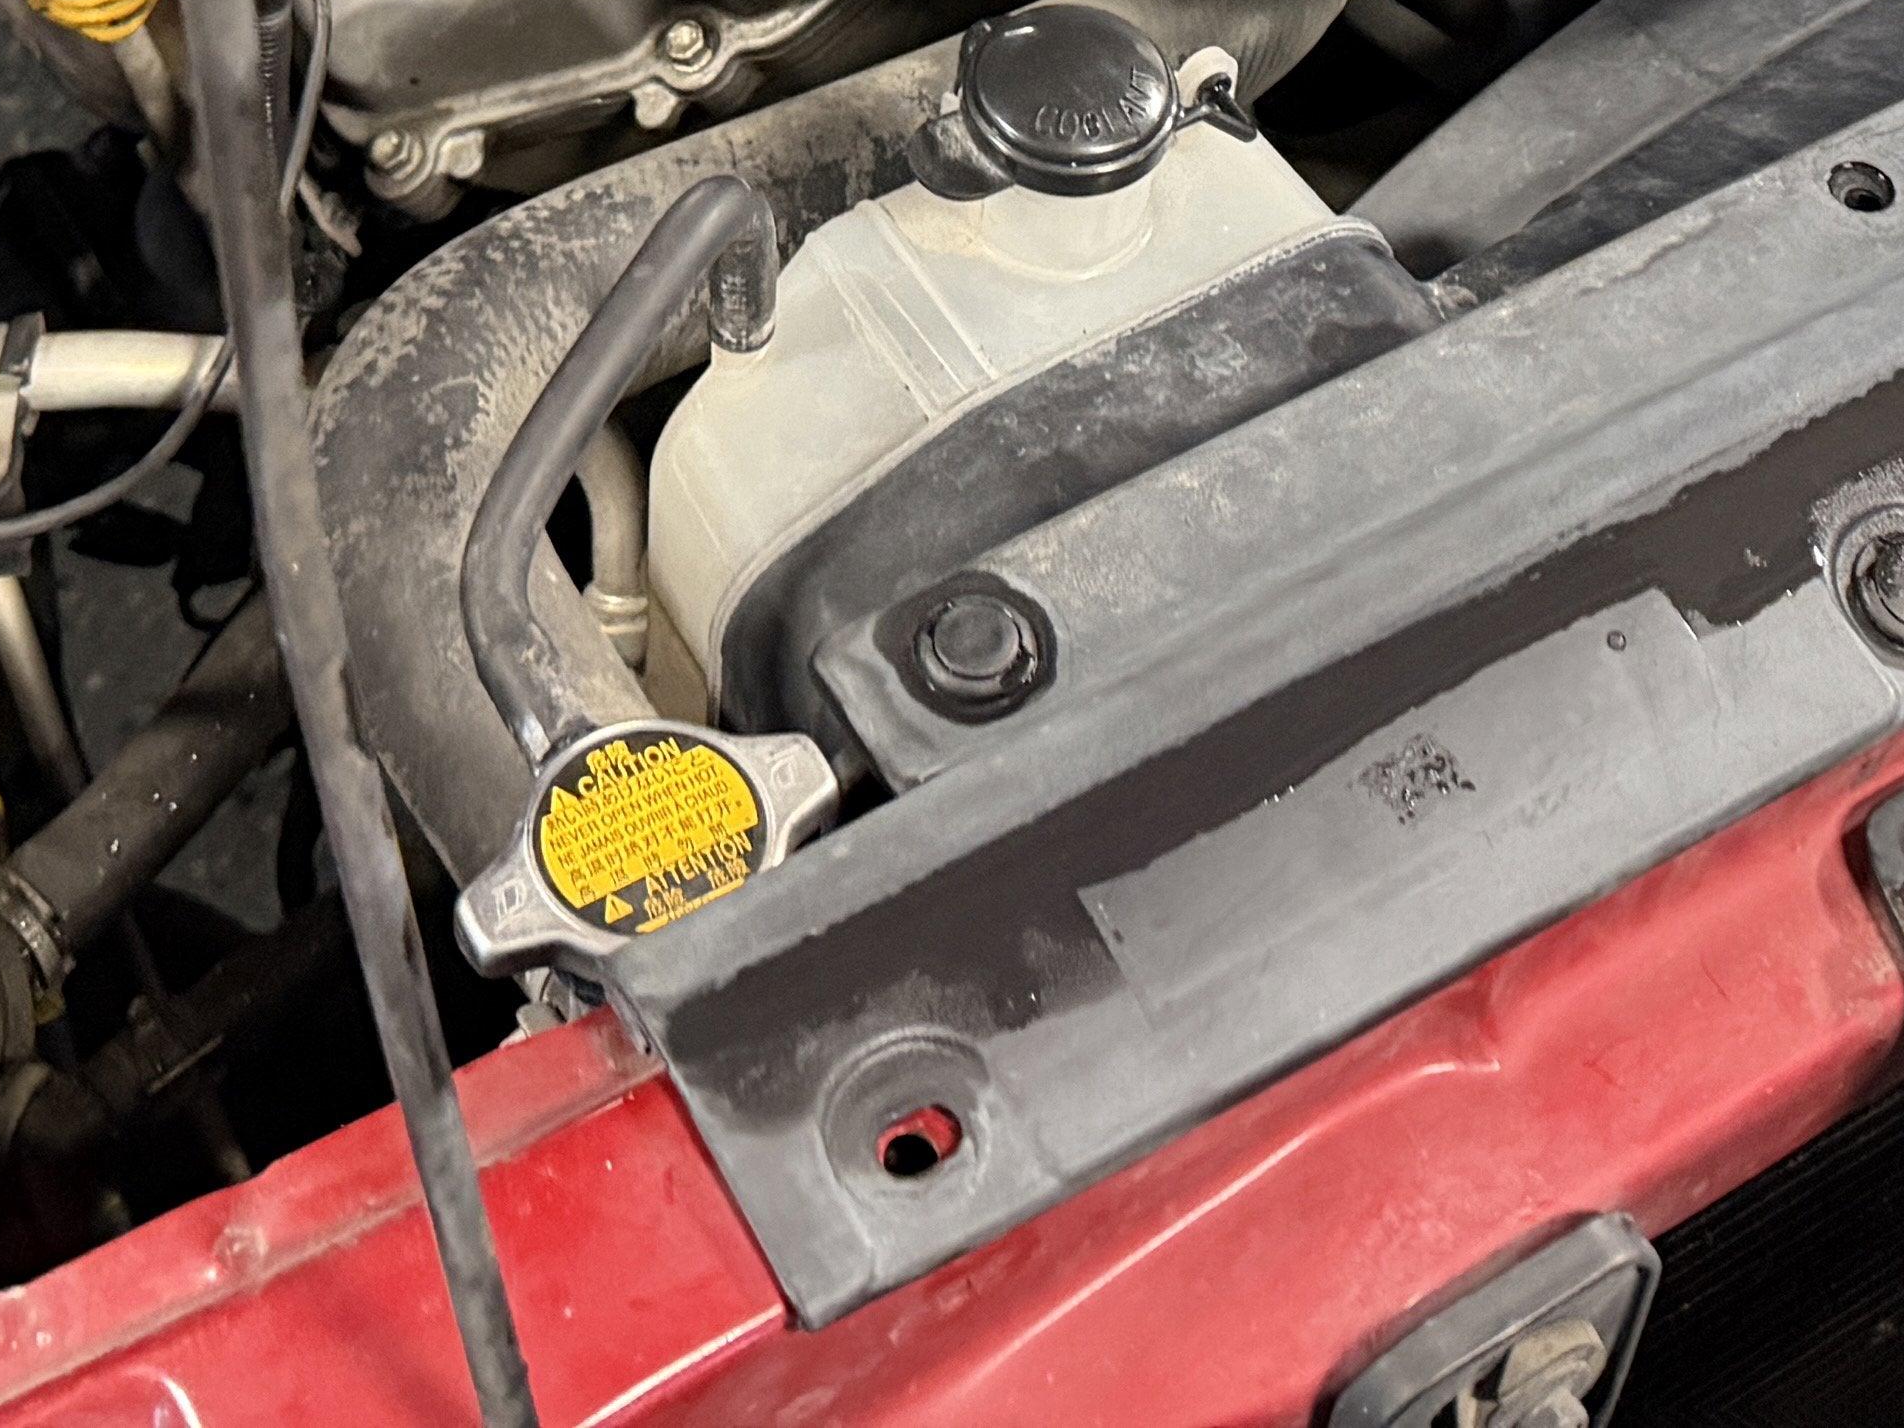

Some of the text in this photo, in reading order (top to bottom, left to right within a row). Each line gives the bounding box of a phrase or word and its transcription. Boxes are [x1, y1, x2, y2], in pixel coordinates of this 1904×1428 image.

[1034, 64, 1159, 142] COOLANT
[578, 736, 682, 797] CAUTION
[549, 820, 601, 854] NEVER
[600, 800, 643, 829] OPEN
[643, 778, 689, 808] WHEN
[577, 829, 625, 861] JAMAIS
[624, 805, 674, 838] OUVRIR
[645, 830, 753, 896] ATTENTION
